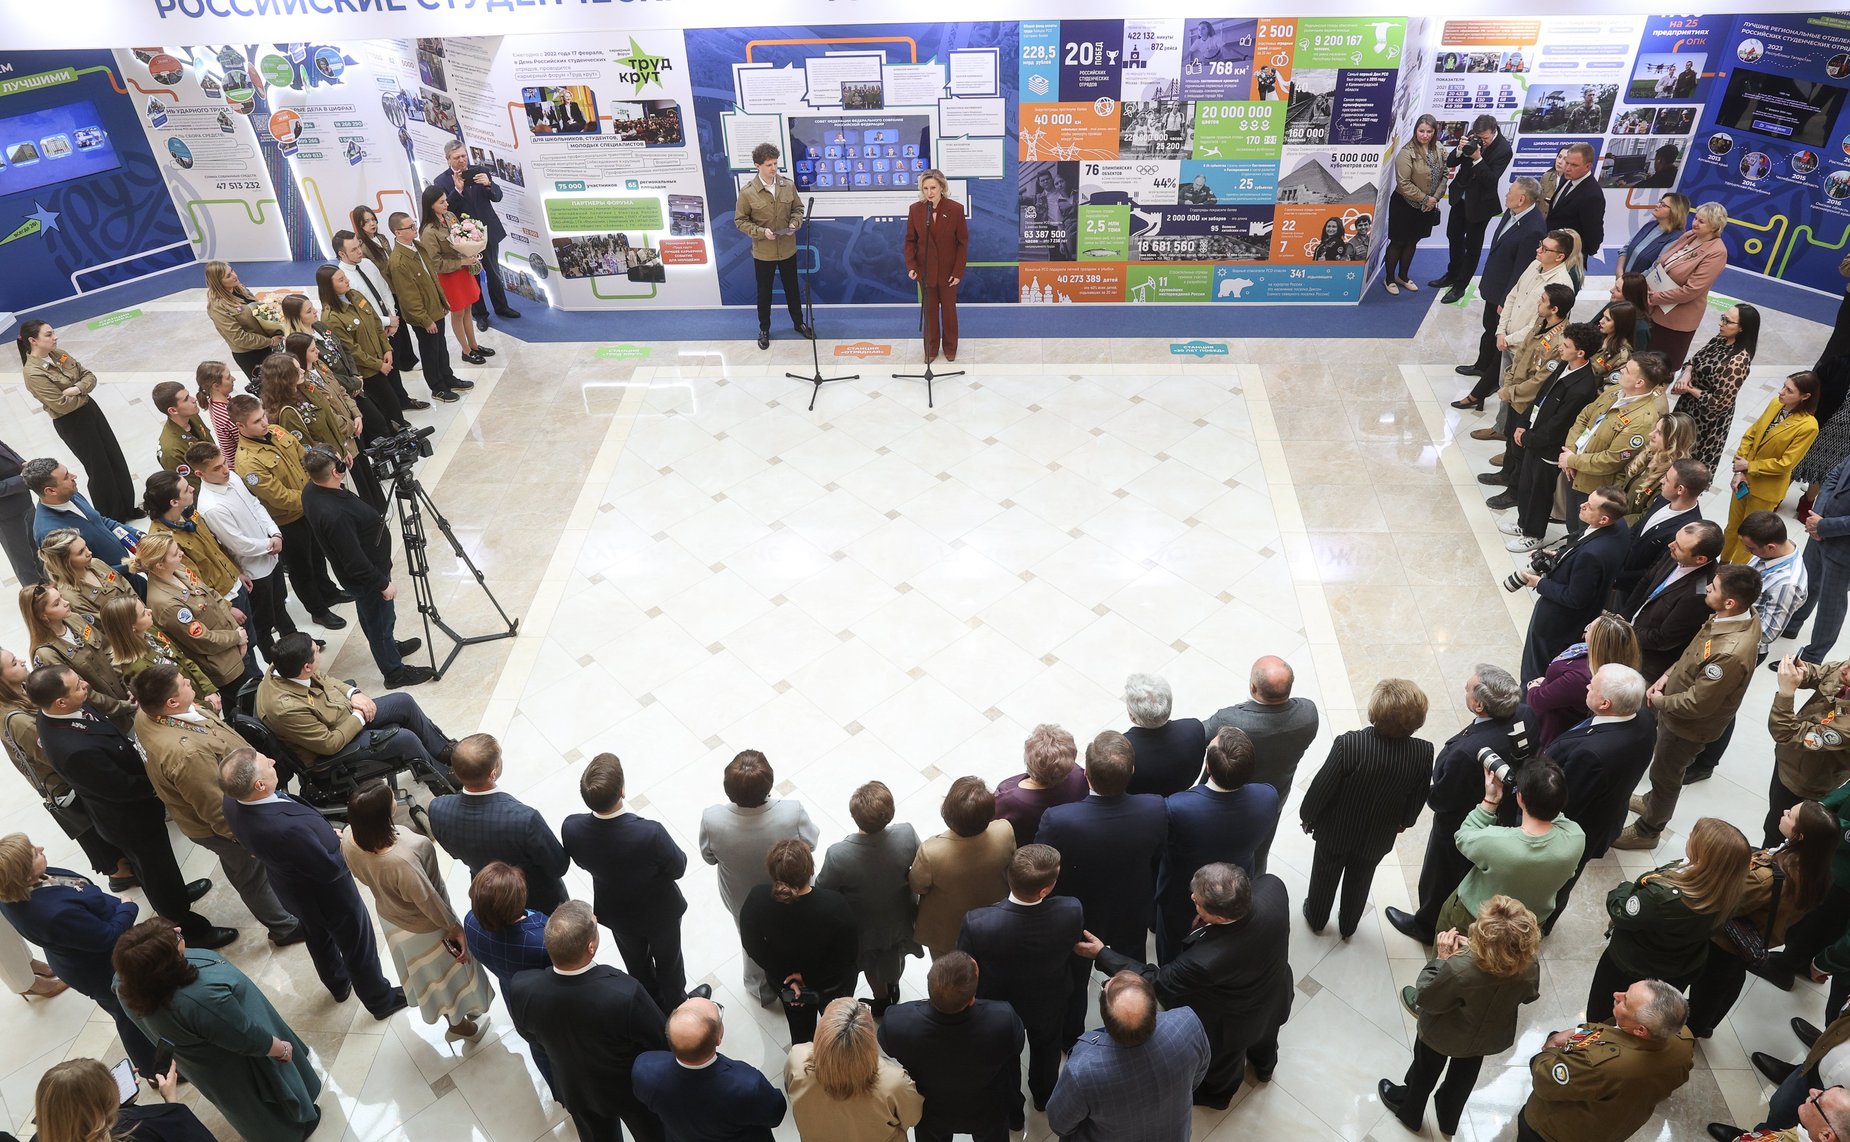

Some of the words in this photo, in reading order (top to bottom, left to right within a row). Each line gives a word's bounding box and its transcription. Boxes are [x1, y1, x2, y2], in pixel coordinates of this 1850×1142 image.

[1669, 20, 1683, 28] на
[1684, 19, 1699, 28] 25
[1258, 25, 1267, 38] 2
[1270, 25, 1294, 38] 500
[1652, 29, 1710, 37] предприятиях
[1743, 21, 1770, 31] ЛУЧШИЕ
[1770, 25, 1821, 39] РЕГИОНАЛЬНЫЕ
[1128, 32, 1141, 40] 422
[1315, 35, 1322, 46] 9
[1324, 35, 1344, 46] 200
[1346, 35, 1363, 46] 167
[1741, 28, 1782, 40] РОССИЙСКИХ
[1782, 36, 1830, 49] СТУДЕНЧЕСКИХ
[1023, 45, 1056, 60] 228,5
[1151, 43, 1164, 51] 872
[1767, 43, 1783, 51] 2023
[1065, 41, 1094, 66] 20
[1094, 41, 1104, 65] ПОБЕД
[1765, 50, 1790, 59] Республика
[629, 57, 673, 72] труд
[1209, 62, 1233, 75] 768
[3, 71, 71, 92] ЛУЧШИМИ
[619, 70, 660, 85] крут
[1202, 105, 1218, 119] 20
[1220, 105, 1245, 119] 000
[1248, 105, 1272, 118] 000
[1034, 114, 1048, 125] 40
[1051, 114, 1072, 125] 000
[1289, 128, 1304, 138] 160
[1306, 128, 1325, 138] 000
[599, 141, 645, 149] СПЕЦИАЛИСТОВ
[1246, 135, 1260, 145] 170
[1166, 142, 1180, 150] 200
[1331, 153, 1338, 162] 5
[1339, 153, 1358, 162] 000
[1360, 153, 1379, 162] 000
[1707, 154, 1721, 162] 2013
[1085, 164, 1100, 176] 76
[1791, 173, 1807, 181] 2015
[245, 181, 260, 189] 232
[1153, 178, 1177, 189] 44%
[1239, 178, 1254, 190] 25
[1741, 179, 1756, 187] 2014
[1826, 198, 1842, 206] 2016
[1086, 219, 1106, 234] 2,5
[1281, 220, 1296, 231] 22
[1024, 230, 1034, 238] 63
[1035, 230, 1050, 238] 387
[1050, 230, 1066, 238] 500
[1137, 241, 1149, 252] 18
[1152, 240, 1171, 252] 681
[1173, 240, 1195, 252] 560
[1280, 240, 1288, 253] 7
[1057, 274, 1068, 283] 40
[1070, 274, 1084, 283] 273
[1085, 274, 1101, 283] 389
[1290, 269, 1306, 279] 341
[1158, 276, 1168, 287] 11
